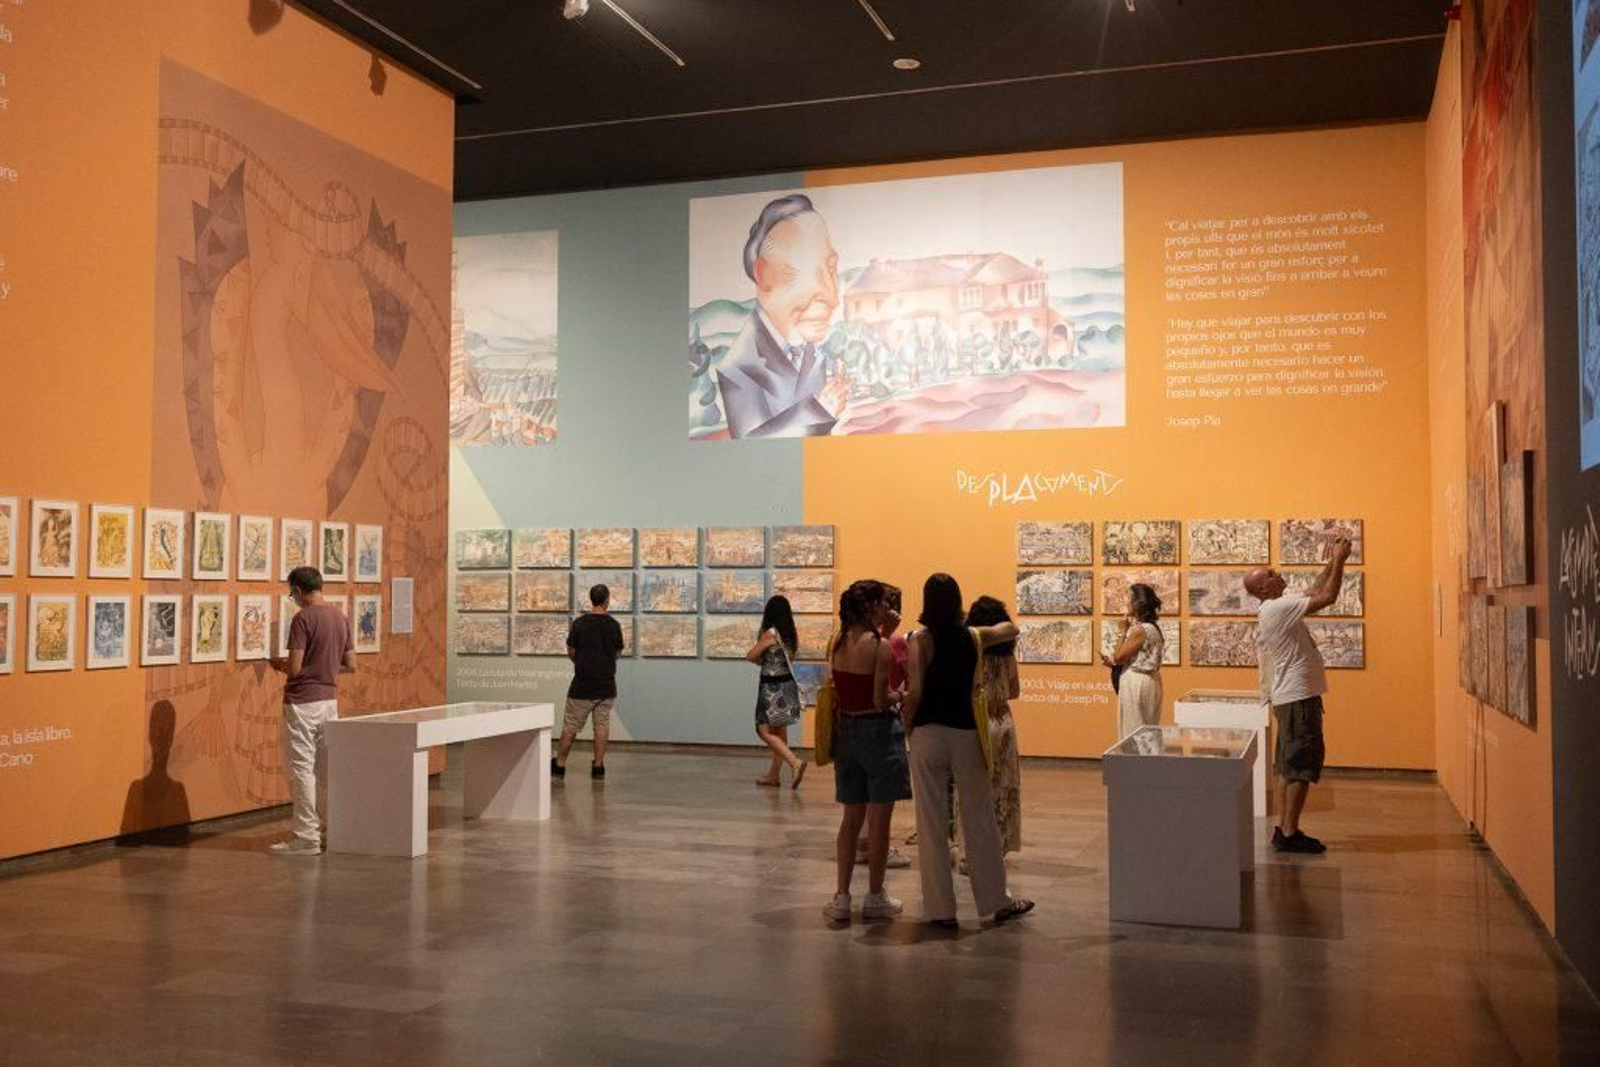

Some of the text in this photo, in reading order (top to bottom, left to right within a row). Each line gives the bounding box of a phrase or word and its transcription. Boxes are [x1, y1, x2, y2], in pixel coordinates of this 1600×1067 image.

[1230, 218, 1248, 228] per
[1252, 218, 1259, 226] a
[1321, 211, 1347, 222] amb
[1351, 209, 1368, 220] els
[1165, 234, 1200, 247] propis
[1226, 232, 1248, 243] que
[1252, 231, 1262, 239] el
[1266, 228, 1291, 239] món
[1312, 225, 1339, 236] molt
[1342, 223, 1384, 235] xicotet
[1175, 248, 1193, 260] per
[1225, 246, 1248, 257] que
[1268, 239, 1346, 254] absolutament
[1221, 260, 1238, 270] fer
[1241, 260, 1256, 269] un
[1259, 258, 1285, 269] gran
[1329, 254, 1348, 264] per
[1352, 254, 1359, 262] a
[1165, 275, 1220, 289] dignificar
[1222, 273, 1232, 284] la
[1266, 271, 1286, 281] fins
[1290, 271, 1297, 280] a
[1343, 268, 1349, 277] a
[1354, 267, 1387, 277] veure
[1166, 289, 1181, 300] les
[1185, 288, 1218, 299] coses
[1221, 288, 1235, 298] en
[1195, 319, 1217, 330] que
[1221, 316, 1252, 328] viajar
[1255, 314, 1280, 326] para
[1284, 312, 1339, 323] descubrir
[1343, 311, 1365, 321] con
[1369, 309, 1386, 319] los
[1166, 324, 1367, 343] propios ojos que el mundo es muy
[1166, 344, 1216, 357] pequeño
[1232, 343, 1251, 354] por
[1291, 341, 1314, 352] que
[1317, 341, 1333, 350] es
[1164, 353, 1364, 371] absolutamente necesario hacer un
[1166, 365, 1384, 385] gran esfuerzo para dignificar la visión
[1166, 385, 1196, 398] hasta
[1199, 384, 1230, 397] llegar
[1234, 387, 1241, 396] a
[1244, 385, 1262, 395] ver
[1266, 383, 1282, 394] las
[1286, 382, 1319, 393] cosas
[1323, 382, 1338, 392] en
[1165, 412, 1221, 428] Josep Pla
[1047, 680, 1070, 692] Viaje
[1071, 682, 1085, 690] en
[1047, 693, 1060, 703] de
[1061, 694, 1092, 706] Josep
[1093, 695, 1109, 704] Pla
[13, 729, 23, 744] la
[0, 752, 34, 767] Cano
